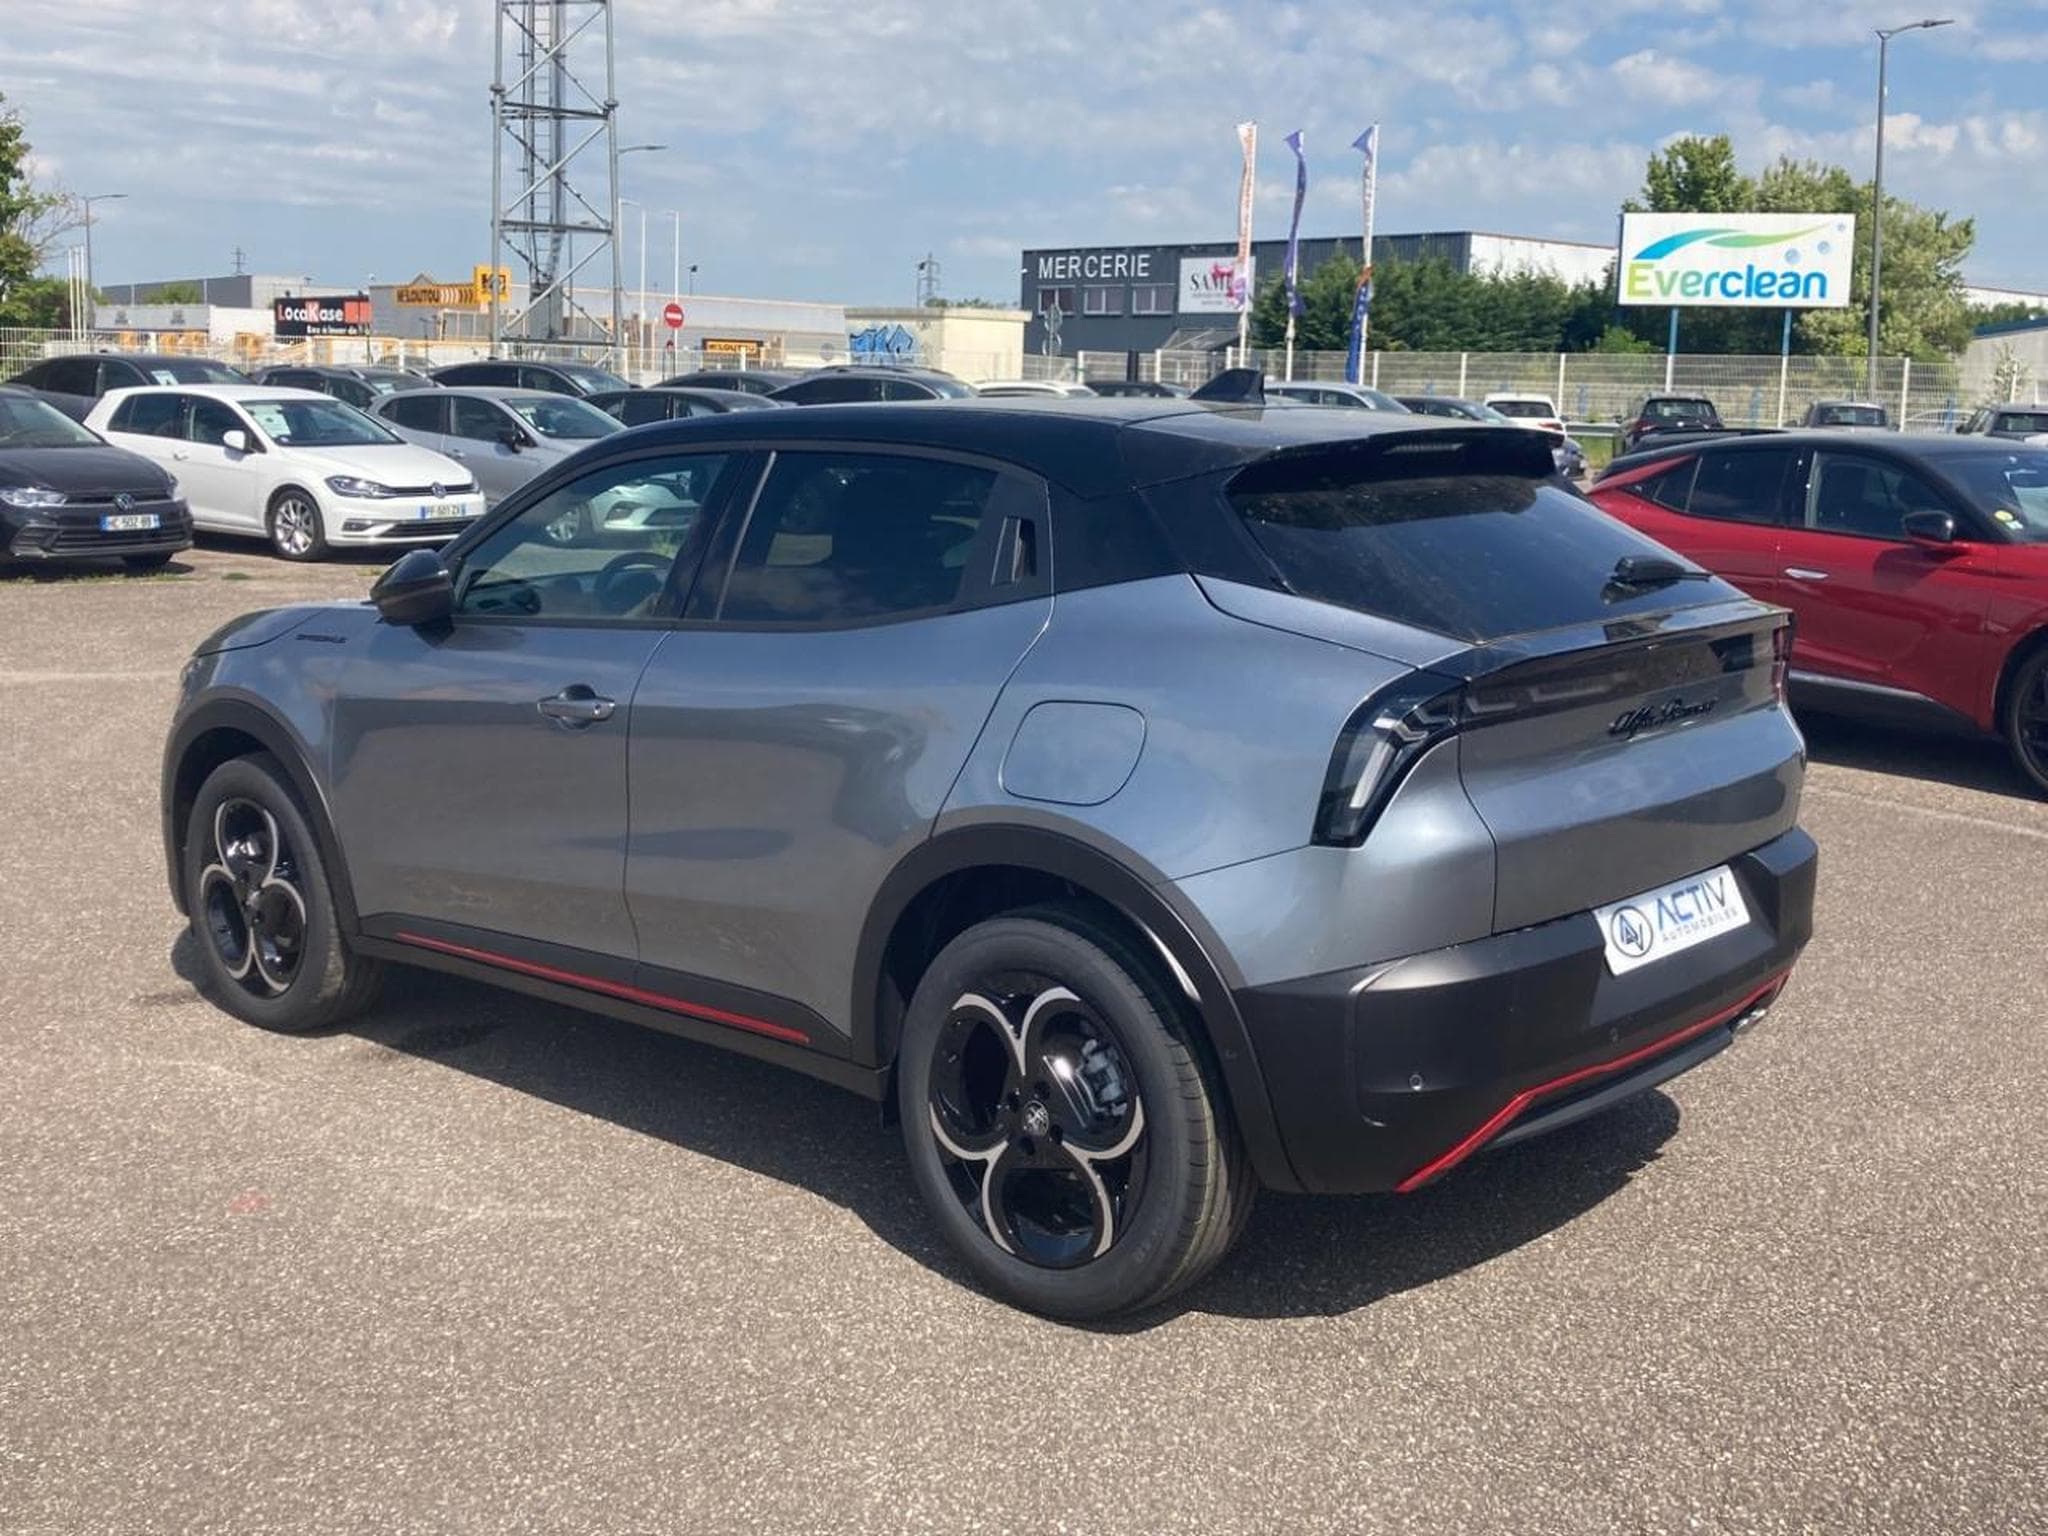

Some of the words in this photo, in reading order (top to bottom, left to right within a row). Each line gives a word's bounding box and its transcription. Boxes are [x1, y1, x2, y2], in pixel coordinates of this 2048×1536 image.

[1038, 254, 1151, 279] MERCERIE
[1627, 263, 1828, 299] Everclean
[1657, 876, 1727, 931] ACTIV
[1663, 906, 1739, 943] AUTOMOBILES
